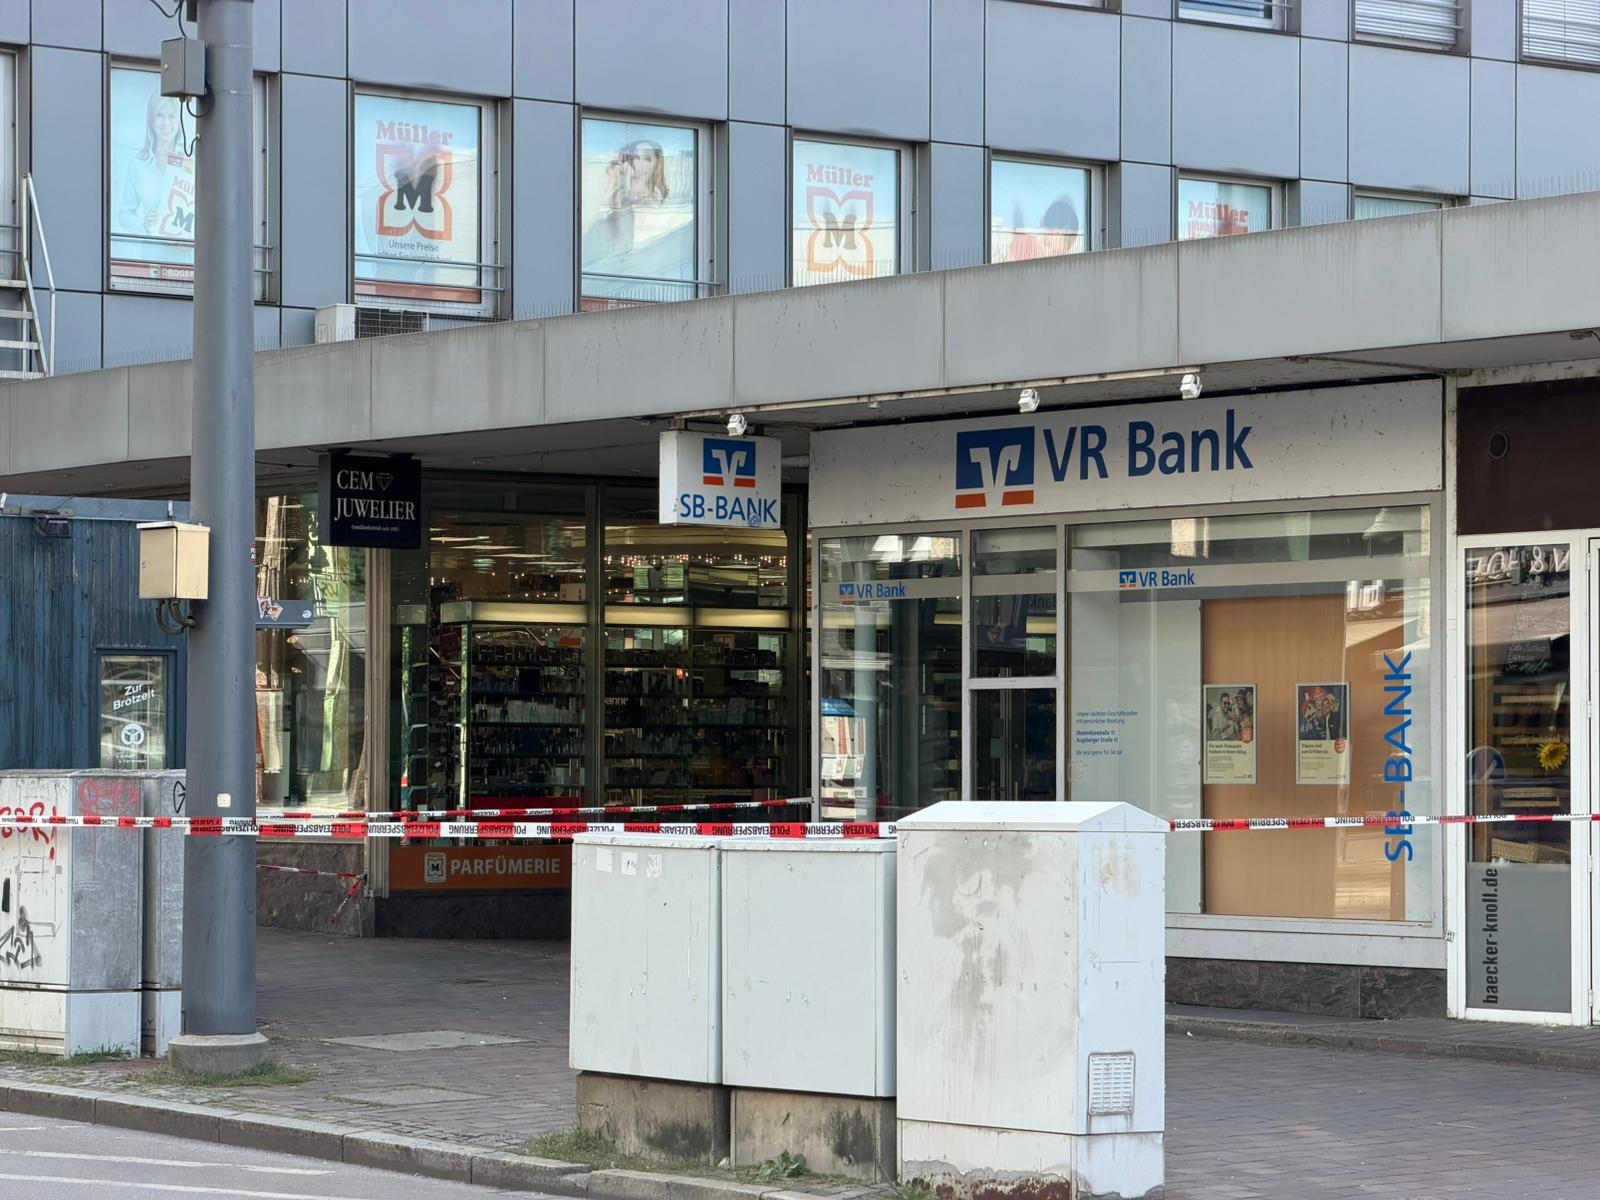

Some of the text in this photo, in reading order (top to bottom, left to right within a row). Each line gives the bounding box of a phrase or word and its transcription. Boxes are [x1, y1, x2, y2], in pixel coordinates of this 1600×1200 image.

[376, 120, 453, 145] Müller
[806, 163, 874, 188] Müller
[1188, 200, 1249, 223] Müller
[388, 240, 440, 252] Unsere Preise
[1043, 408, 1254, 482] VR Bank
[337, 469, 374, 491] CEM
[334, 498, 416, 521] JUWELIER
[680, 493, 778, 524] SB-BANK
[1139, 568, 1195, 587] VR Bank
[857, 581, 906, 598] VR Bank
[113, 689, 155, 710] Brotzeit
[124, 682, 144, 696] Zur
[1383, 651, 1413, 861] SB-BANK
[273, 823, 351, 834] POLIZEIABSPERRUNG
[361, 824, 440, 835] POLIZEIABSPERRUNG
[448, 824, 527, 835] POLIZEIABSPERRUNG
[712, 825, 790, 836] POLIZEIABSPERRUNG
[800, 824, 879, 835] POLIZEIABSPERRUNG
[1170, 820, 1234, 829] POLIZEIABSPERR
[451, 856, 561, 875] PARFÜMERIE
[1482, 868, 1499, 1004] baecker-knoll.de
